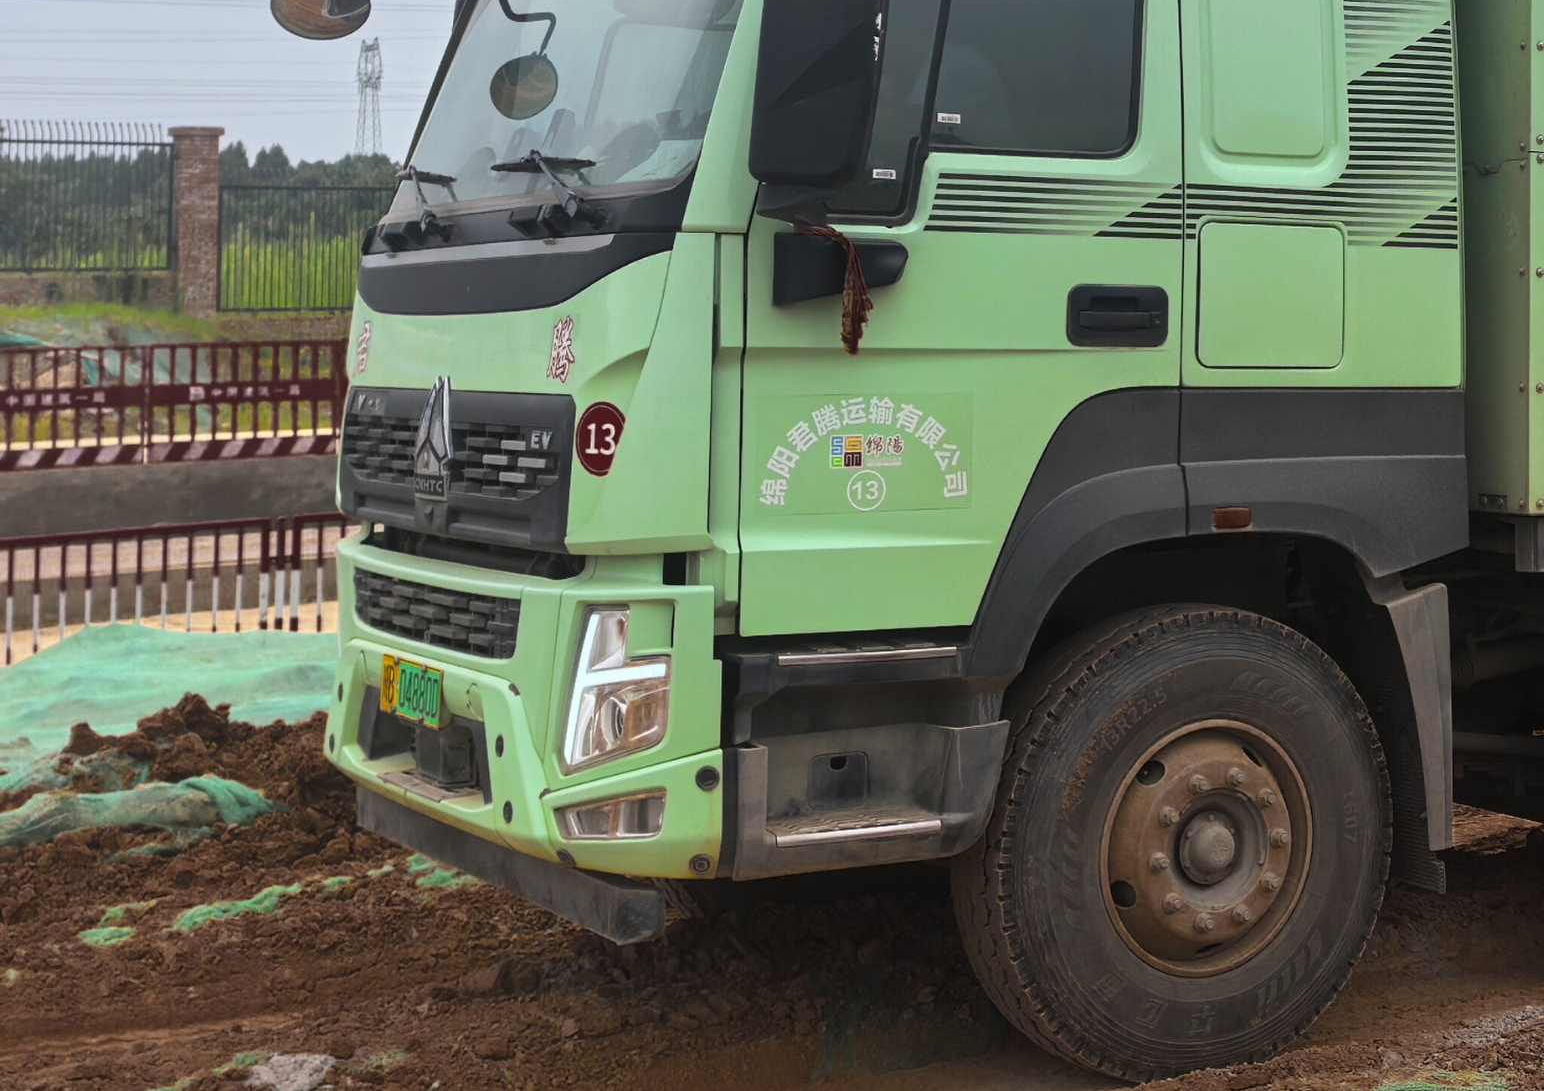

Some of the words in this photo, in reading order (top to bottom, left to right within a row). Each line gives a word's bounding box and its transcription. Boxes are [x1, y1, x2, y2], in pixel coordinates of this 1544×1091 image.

[584, 422, 616, 456] 13
[758, 395, 968, 507] 绵阳君腾运输有限公司
[851, 481, 879, 500] 13
